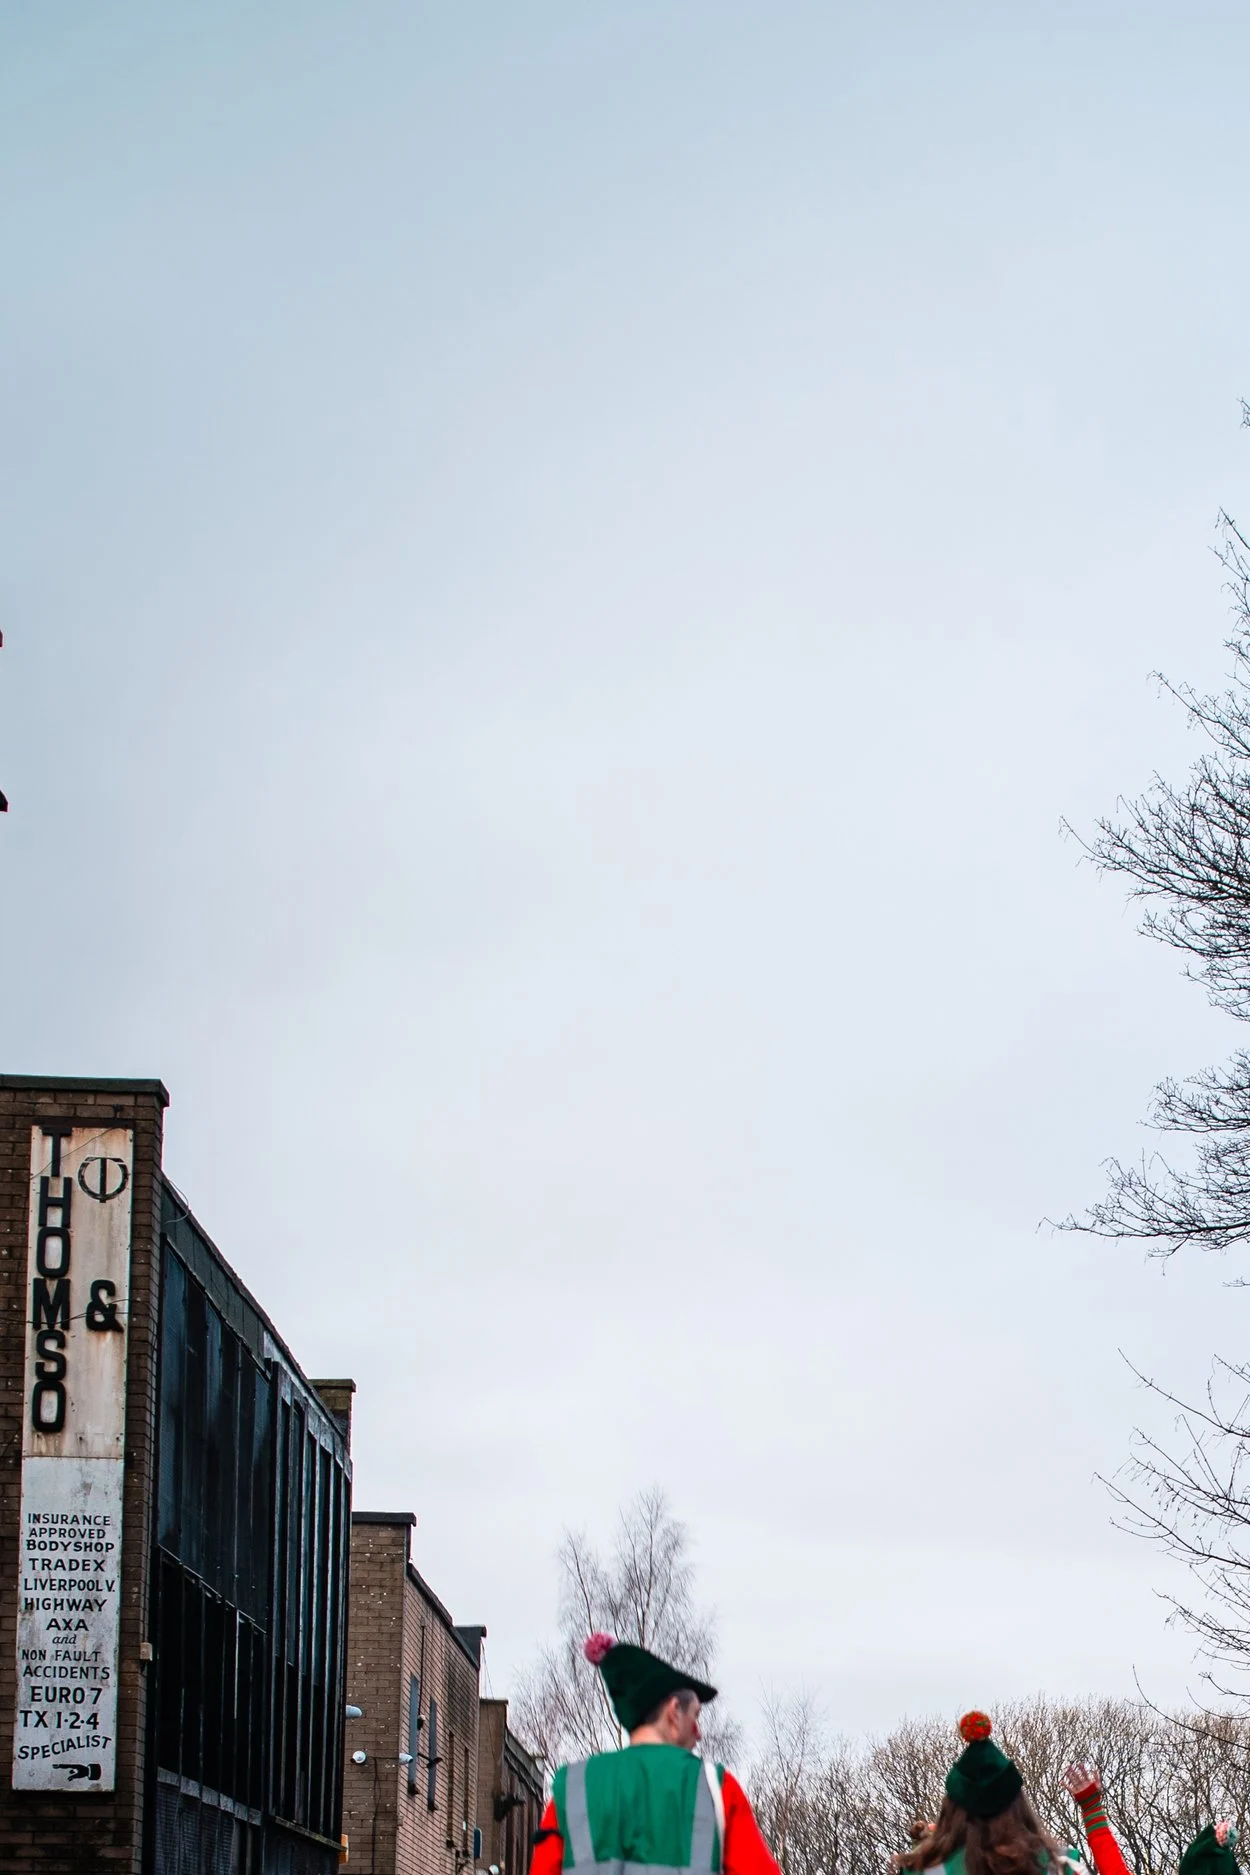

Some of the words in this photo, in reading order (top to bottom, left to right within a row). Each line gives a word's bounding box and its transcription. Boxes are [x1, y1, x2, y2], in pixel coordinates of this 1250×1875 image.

[86, 1279, 125, 1333] &
[28, 1513, 111, 1526] INSURANCE
[29, 1527, 106, 1539] APPROVED
[26, 1539, 115, 1552] BODYSHOP
[29, 1558, 106, 1572] TRADEX
[24, 1578, 105, 1592] LIVERPOOL
[24, 1597, 107, 1612] HIGHWAY
[46, 1618, 89, 1631] AXA
[52, 1634, 77, 1644] and
[22, 1649, 47, 1660] NON
[55, 1650, 101, 1662] FAULT
[22, 1665, 110, 1680] ACCIDENTS
[30, 1686, 86, 1704] EURO
[90, 1687, 103, 1705] 7
[20, 1710, 49, 1728] TX
[17, 1735, 112, 1760] SPECIALIST
